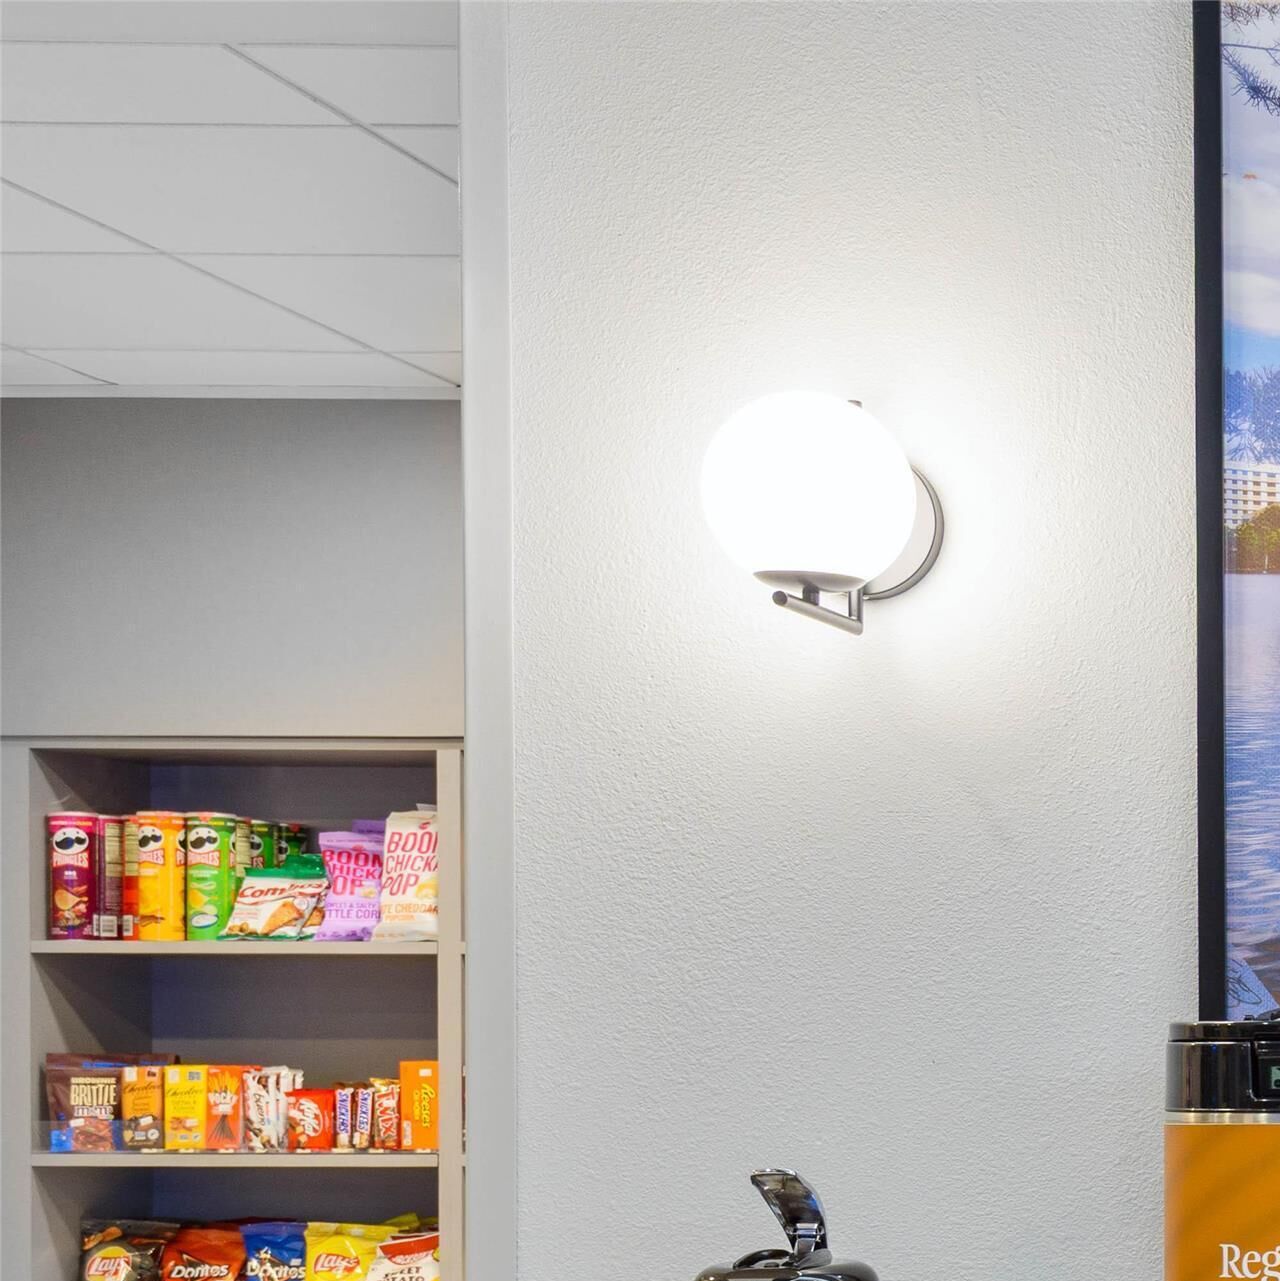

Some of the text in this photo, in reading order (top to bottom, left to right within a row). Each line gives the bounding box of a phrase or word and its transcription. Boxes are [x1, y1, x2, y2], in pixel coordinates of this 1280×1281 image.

[332, 875, 365, 896] OP
[382, 873, 420, 896] POP
[326, 909, 353, 918] TTLE
[70, 1084, 117, 1105] BRITTLE
[338, 1091, 350, 1134] SNICKERS
[171, 1264, 229, 1279] Doritos
